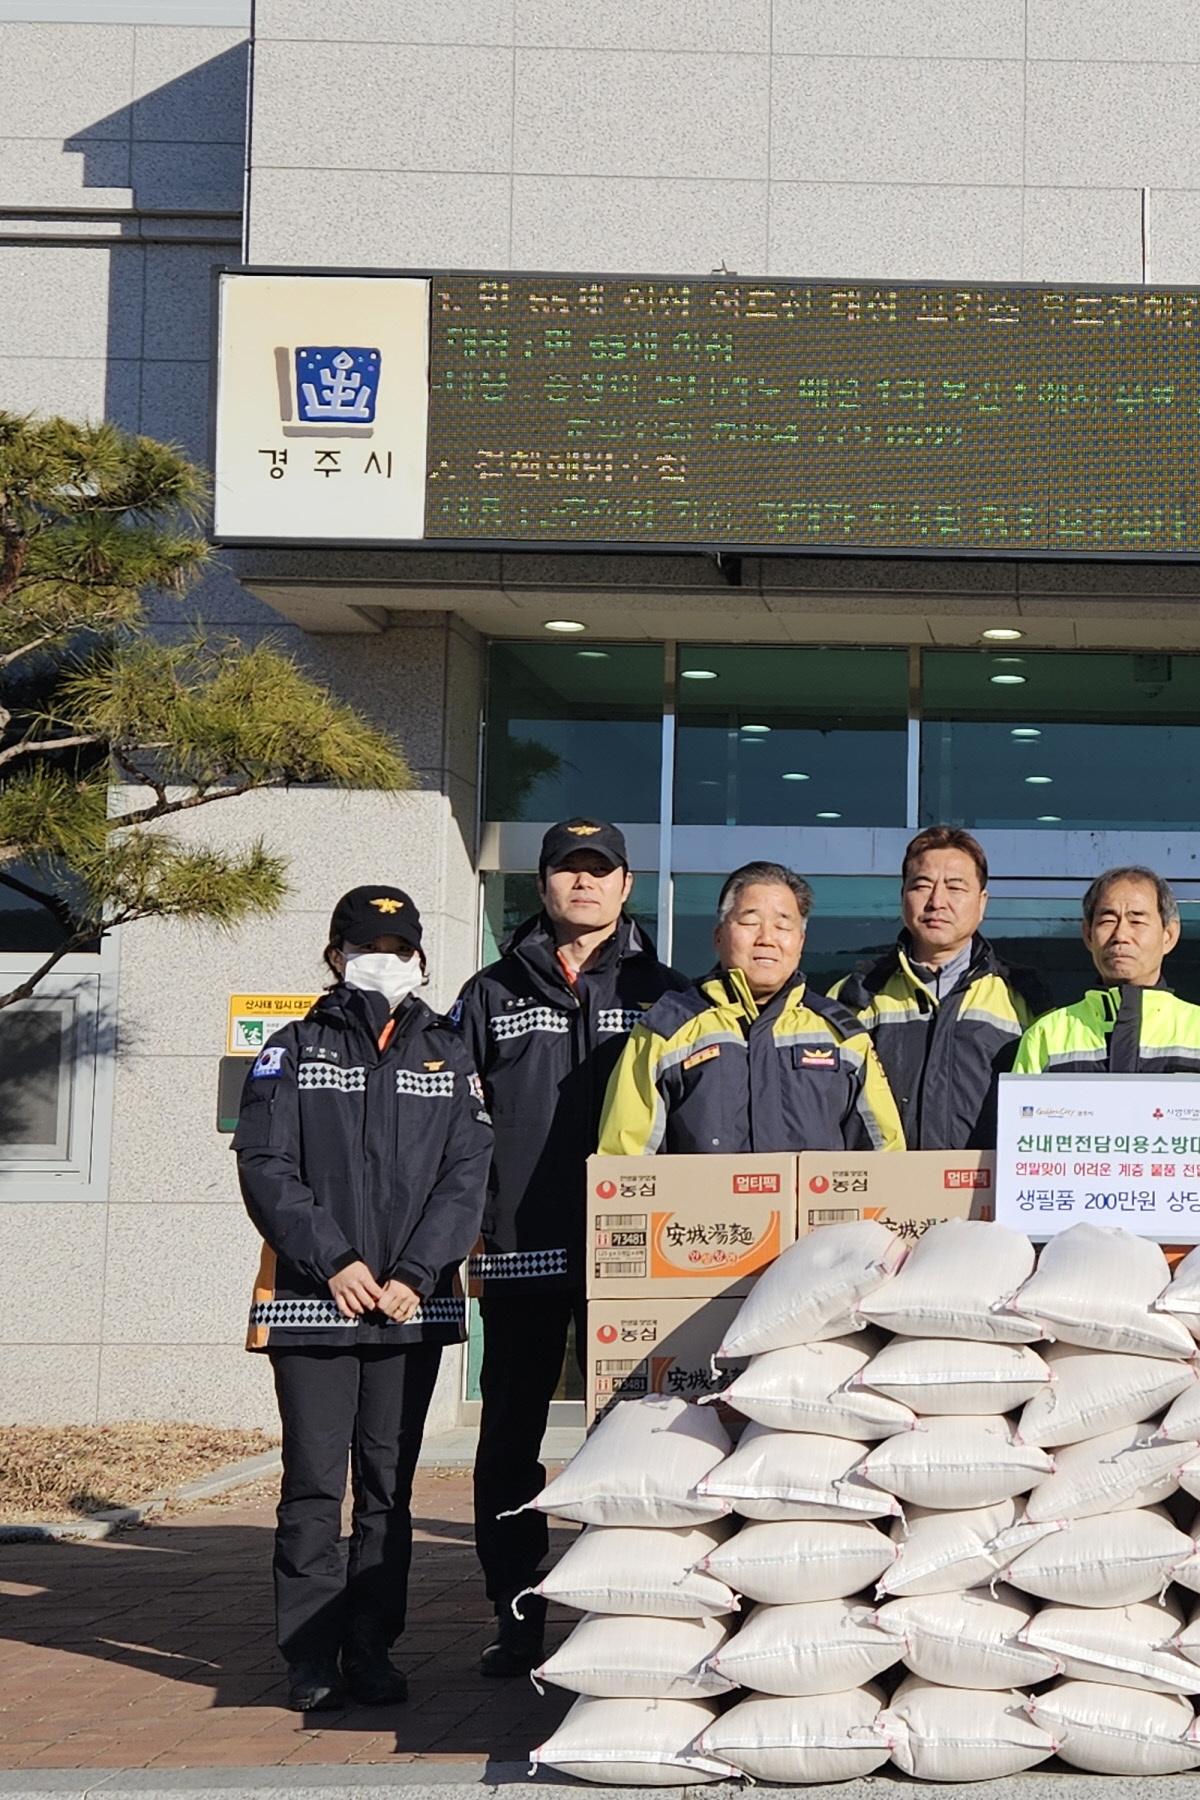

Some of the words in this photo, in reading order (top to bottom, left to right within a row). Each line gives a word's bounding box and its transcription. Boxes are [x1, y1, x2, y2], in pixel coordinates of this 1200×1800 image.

[258, 448, 392, 479] 경주시
[245, 1000, 272, 1010] 산사태
[1015, 1162, 1066, 1176] 연말맞이
[1073, 1162, 1112, 1177] 어려운
[736, 1176, 777, 1191] 멀티팩
[832, 1178, 868, 1193] 농심
[947, 1172, 988, 1186] 멀티팩
[620, 1184, 656, 1198] 농심
[1016, 1190, 1076, 1212] 생필품
[1084, 1190, 1156, 1212] 200만원
[613, 1233, 645, 1245] 가3481
[666, 1222, 752, 1246] 安城湯麵
[621, 1327, 657, 1342] 농심
